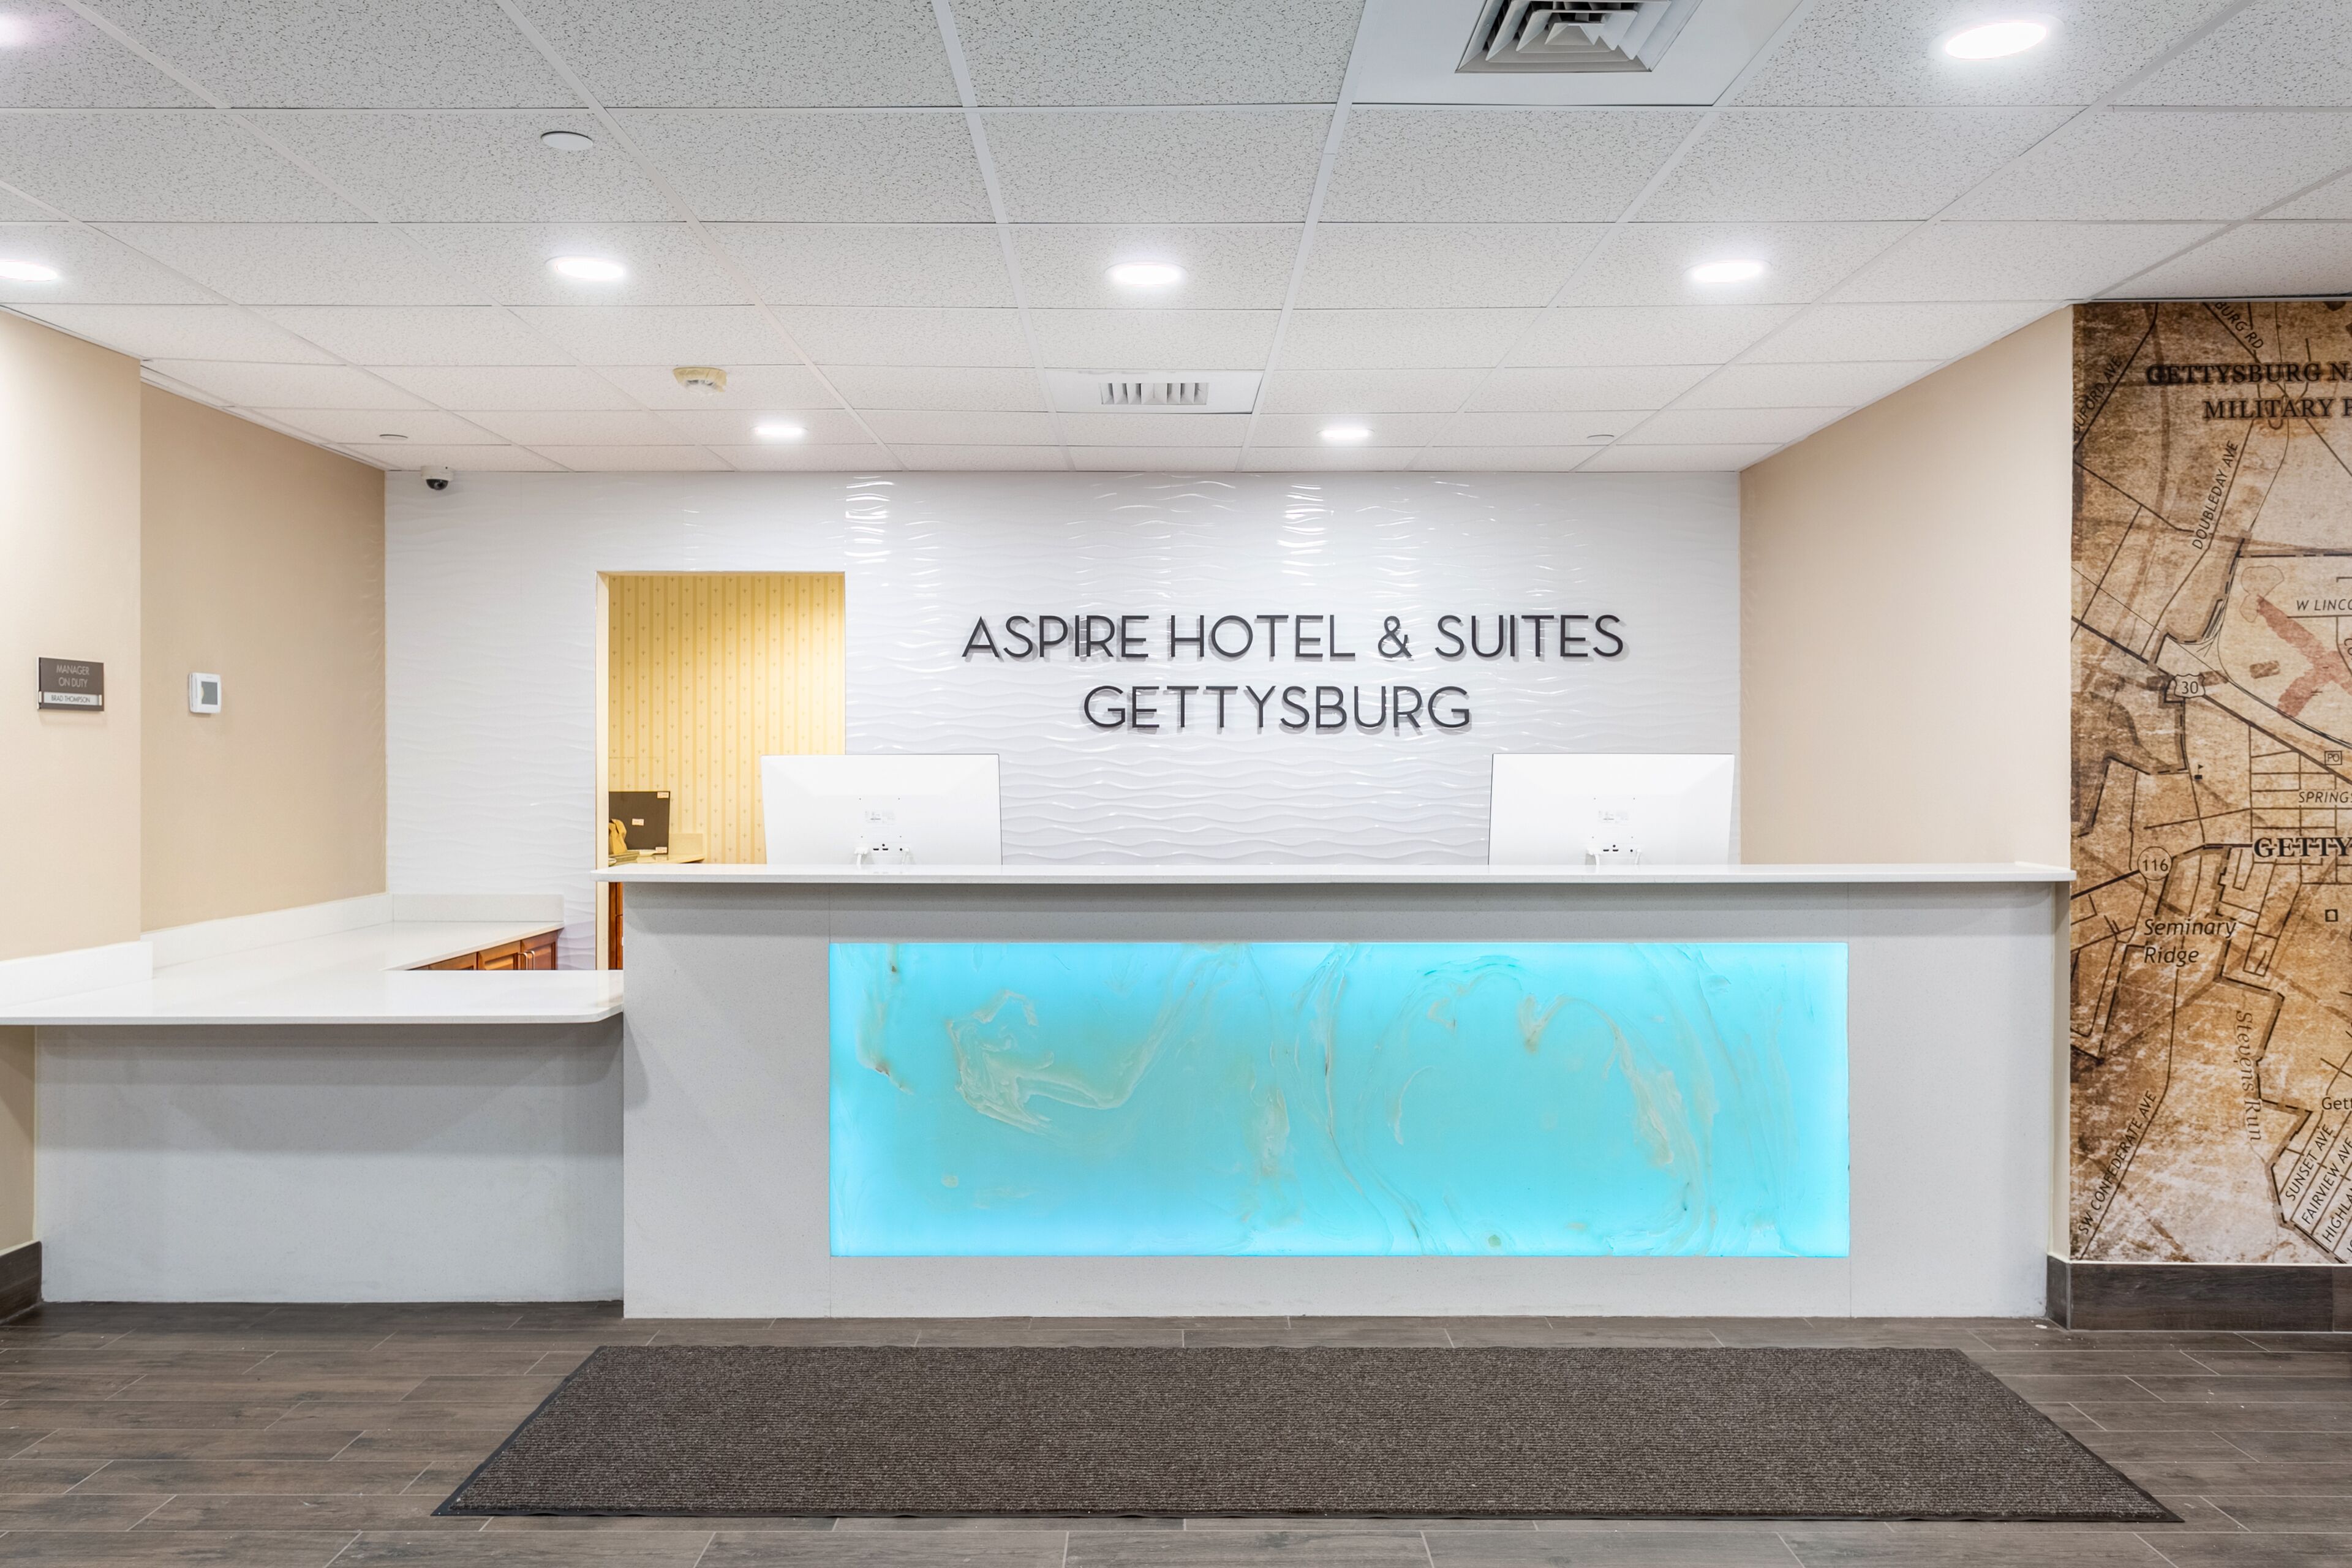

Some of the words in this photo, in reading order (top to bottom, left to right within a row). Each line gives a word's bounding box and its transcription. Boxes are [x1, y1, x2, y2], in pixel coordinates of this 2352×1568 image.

[2244, 331, 2264, 349] RD
[2103, 355, 2122, 383] AVE
[2146, 362, 2321, 385] GETTYSBURG
[2204, 398, 2334, 418] MILITARY
[2192, 468, 2228, 550] DOUBLEDAY
[2221, 440, 2239, 468] AVE
[2296, 599, 2309, 611] W
[962, 614, 1149, 658] ASPIRE
[1170, 614, 1355, 658] HOTEL
[1378, 615, 1412, 658] &
[1434, 614, 1624, 658] SUITES
[56, 664, 90, 675] MANAGER
[59, 677, 70, 687] ON
[71, 677, 88, 687] DUTY
[2181, 680, 2199, 695] 30
[1084, 685, 1470, 728] GETTYSBURG
[2327, 753, 2340, 763] PO
[2298, 791, 2352, 804] SPRING
[2142, 859, 2169, 872] 116
[2144, 918, 2237, 938] Seminary
[2143, 946, 2199, 968] Ridge
[2236, 1010, 2254, 1092] Stevens
[2244, 1099, 2262, 1142] Run
[2078, 1212, 2094, 1235] SW
[2090, 1117, 2143, 1211] CONFEDERATE
[2138, 1090, 2157, 1118] AVE
[2285, 1149, 2318, 1201] SUNSET
[2314, 1123, 2333, 1152] AVE
[2301, 1163, 2340, 1225] FAIRVIEW
